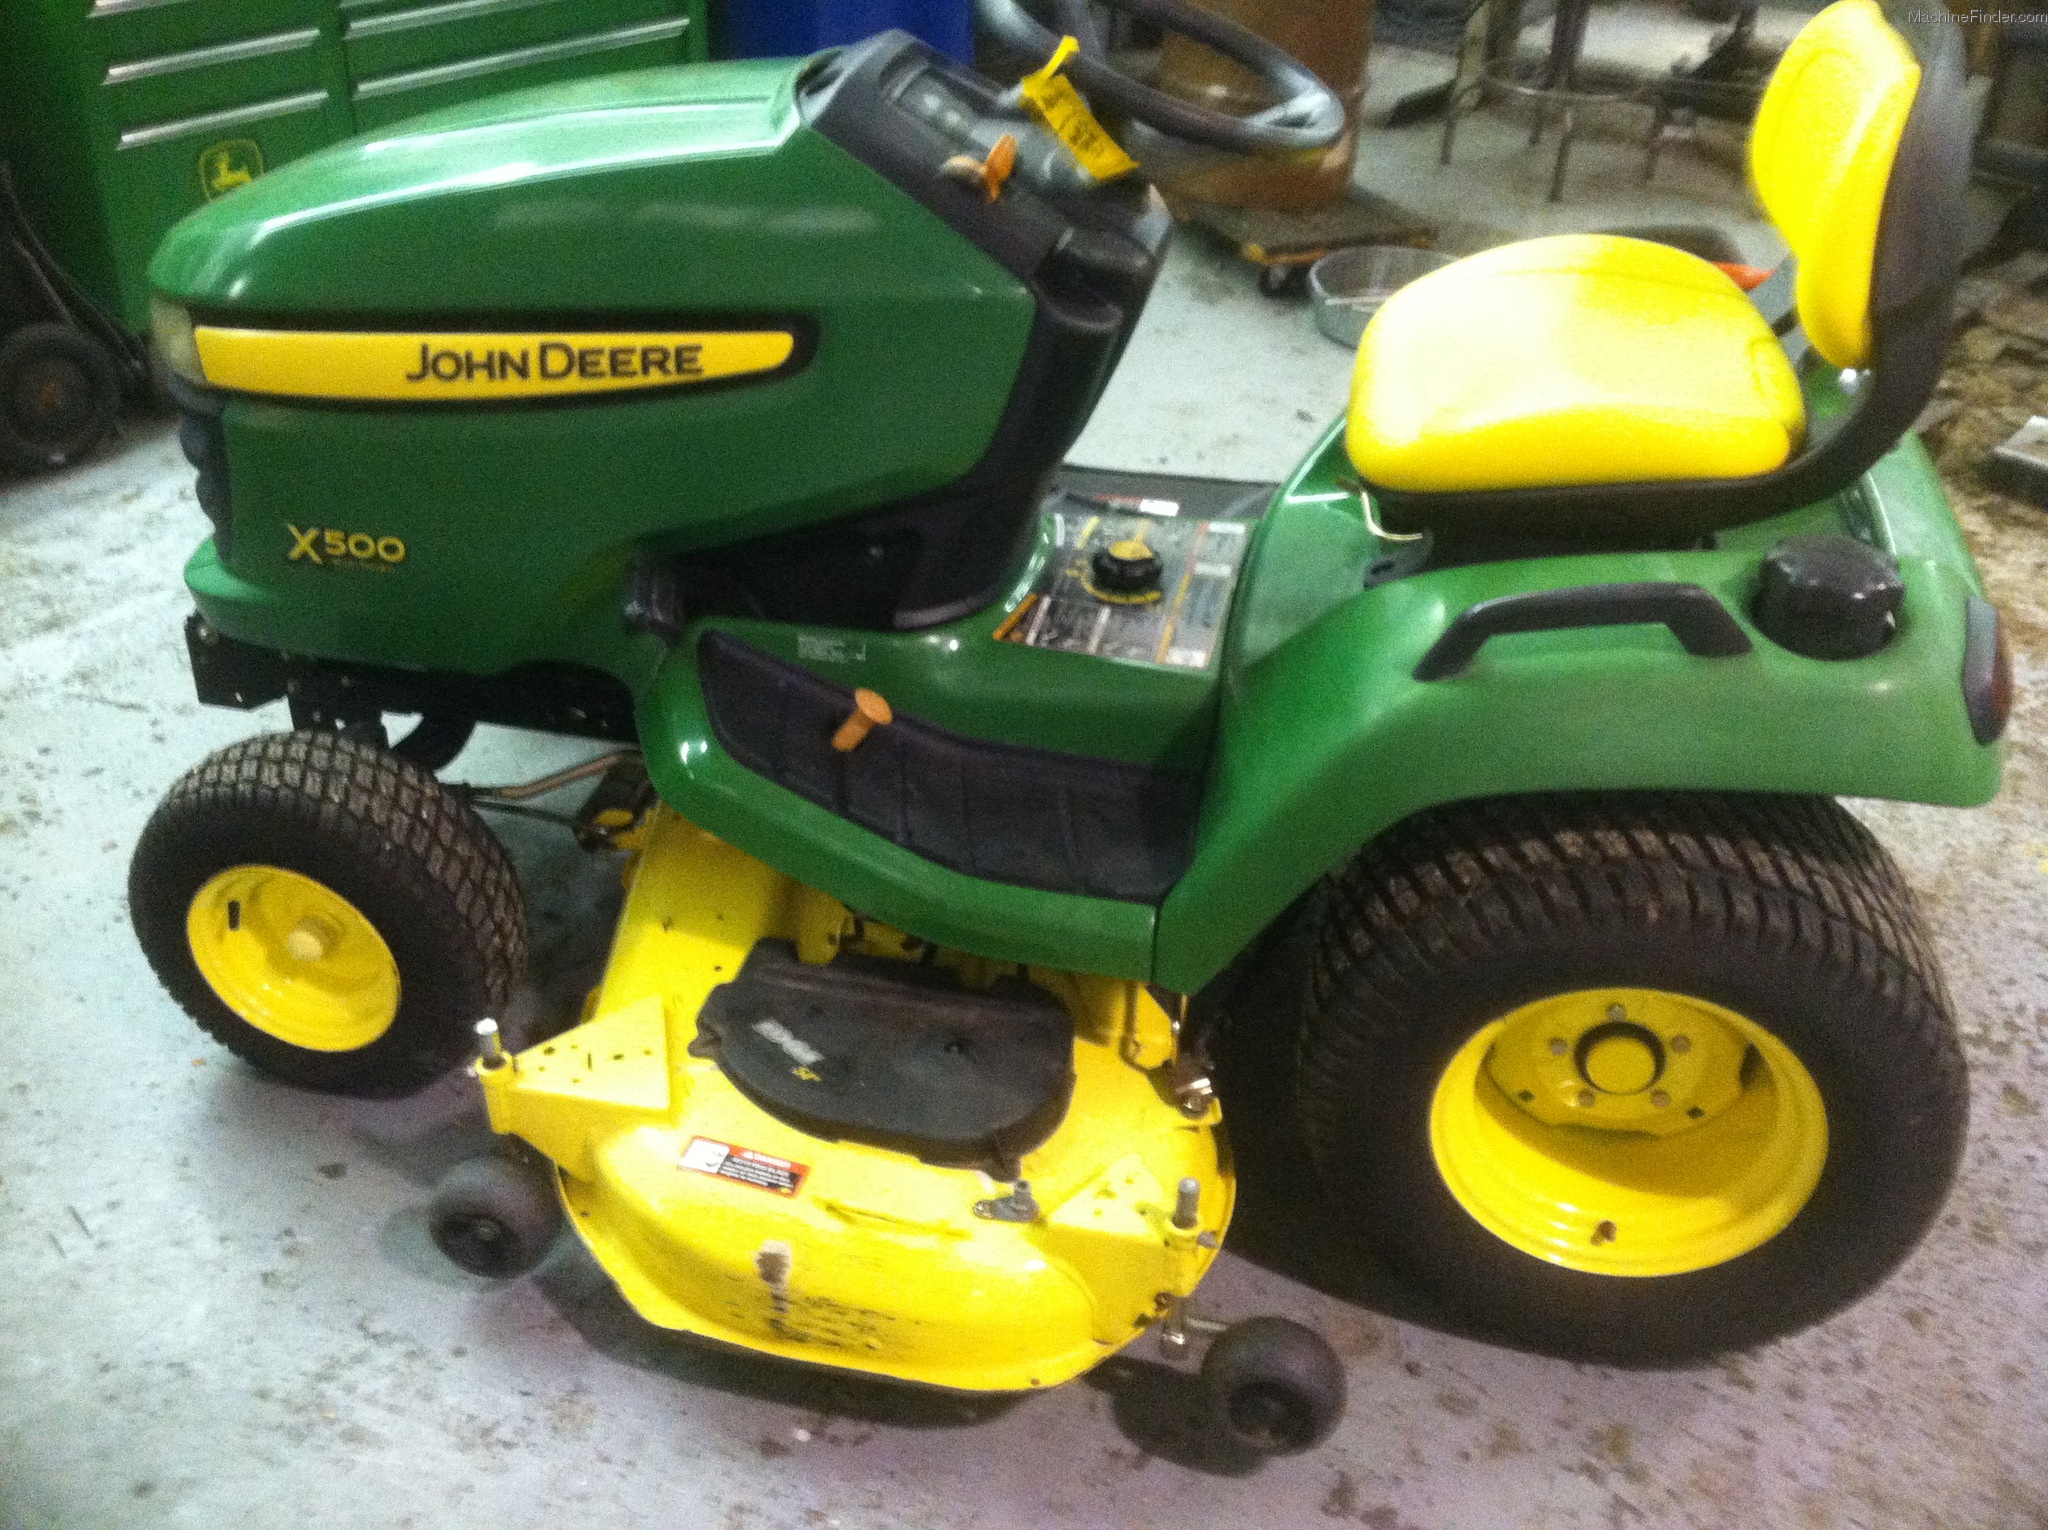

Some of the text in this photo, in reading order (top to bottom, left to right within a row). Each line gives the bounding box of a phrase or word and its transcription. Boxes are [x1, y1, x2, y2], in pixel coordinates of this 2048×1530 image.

[406, 341, 704, 382] JOHN DEERE
[287, 523, 406, 564] X500
